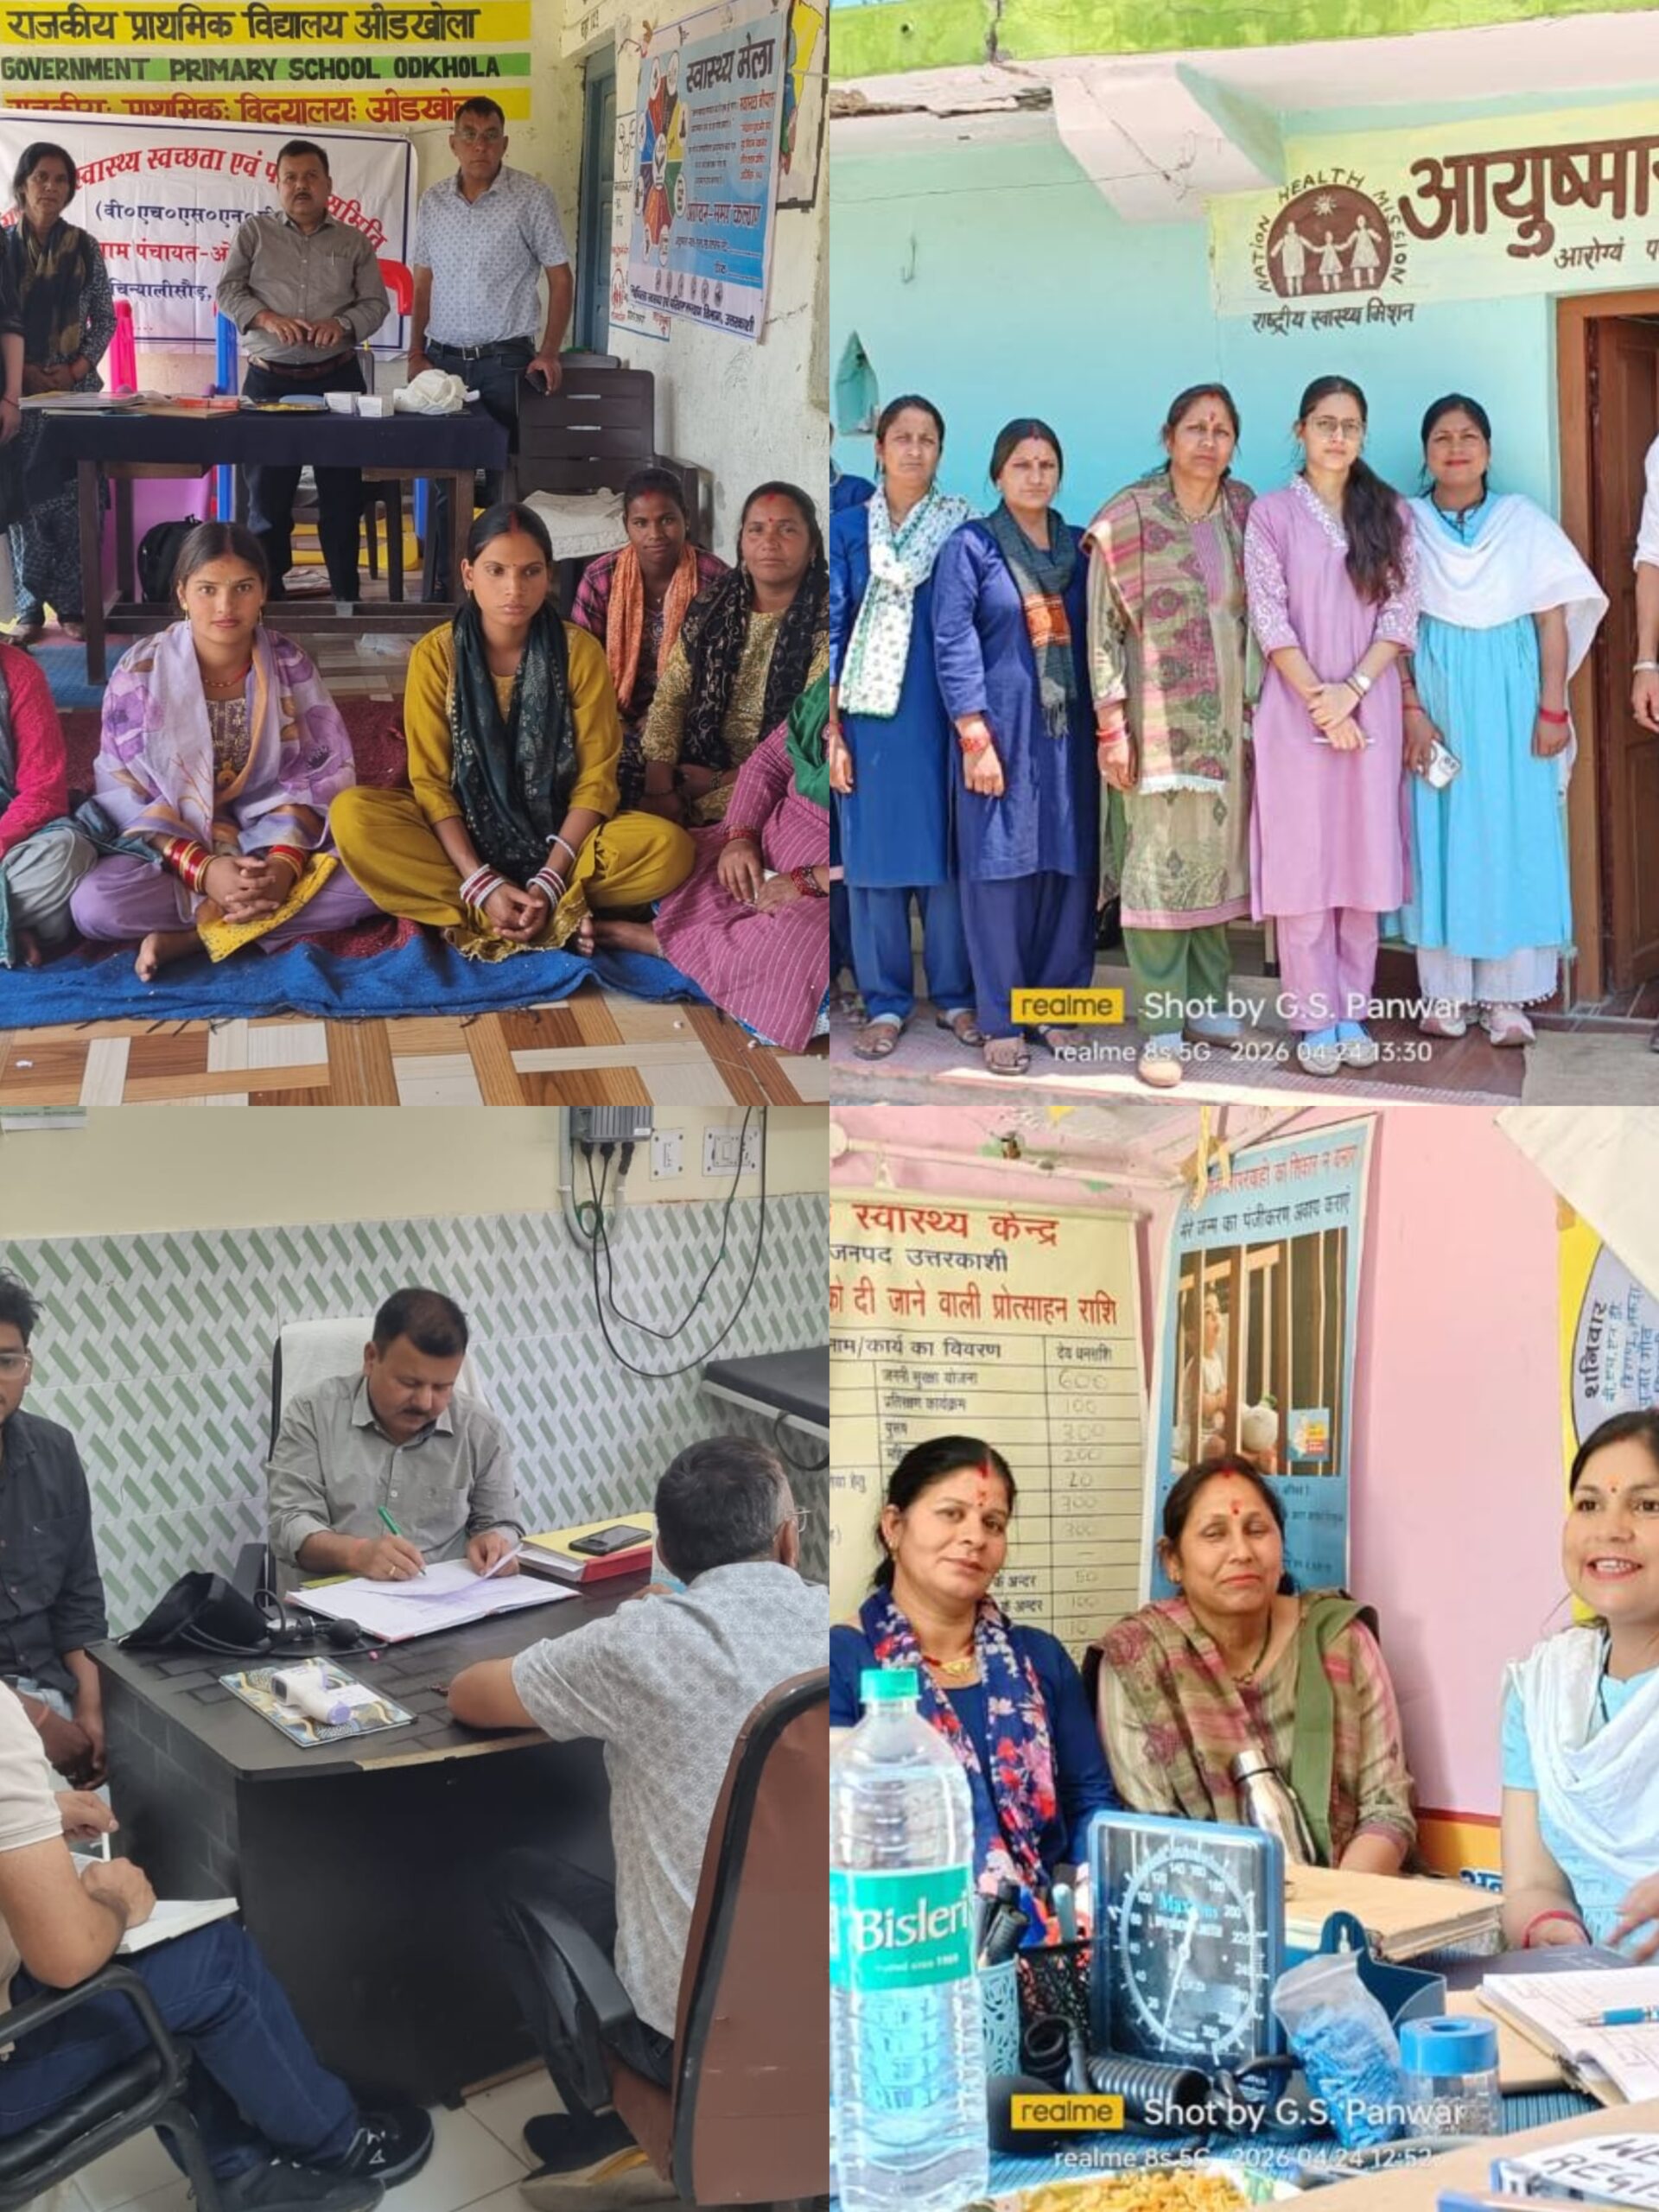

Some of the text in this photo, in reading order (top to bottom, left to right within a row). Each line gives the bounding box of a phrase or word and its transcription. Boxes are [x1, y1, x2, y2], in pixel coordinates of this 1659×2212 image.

[6, 3, 118, 40] राजकीय
[124, 3, 235, 41] प्राथमिक
[241, 2, 349, 40] विद्यालय
[1, 56, 500, 82] GOVERNMENT PRIMARY SCHOOL ODKHOLA
[738, 32, 775, 79] मेला
[148, 147, 226, 172] स्वच्छता
[231, 150, 263, 178] एवं
[1278, 168, 1365, 204] HEALTH
[1365, 297, 1415, 325] मिशन
[852, 1204, 1059, 1246] स्वास्थ्य केन्द्र
[830, 1243, 1008, 1272] जनपद उत्तरकाशी
[854, 1276, 875, 1316] दी
[887, 1279, 925, 1317] जाने
[938, 1281, 981, 1319] वाली
[992, 1284, 1068, 1325] प्रोत्साहन
[1078, 1289, 1117, 1325] राशि
[910, 1338, 935, 1357] का
[944, 1337, 1001, 1358] विवरण
[1579, 1300, 1607, 1399] शनिवार
[854, 1891, 969, 1954] Bisleri
